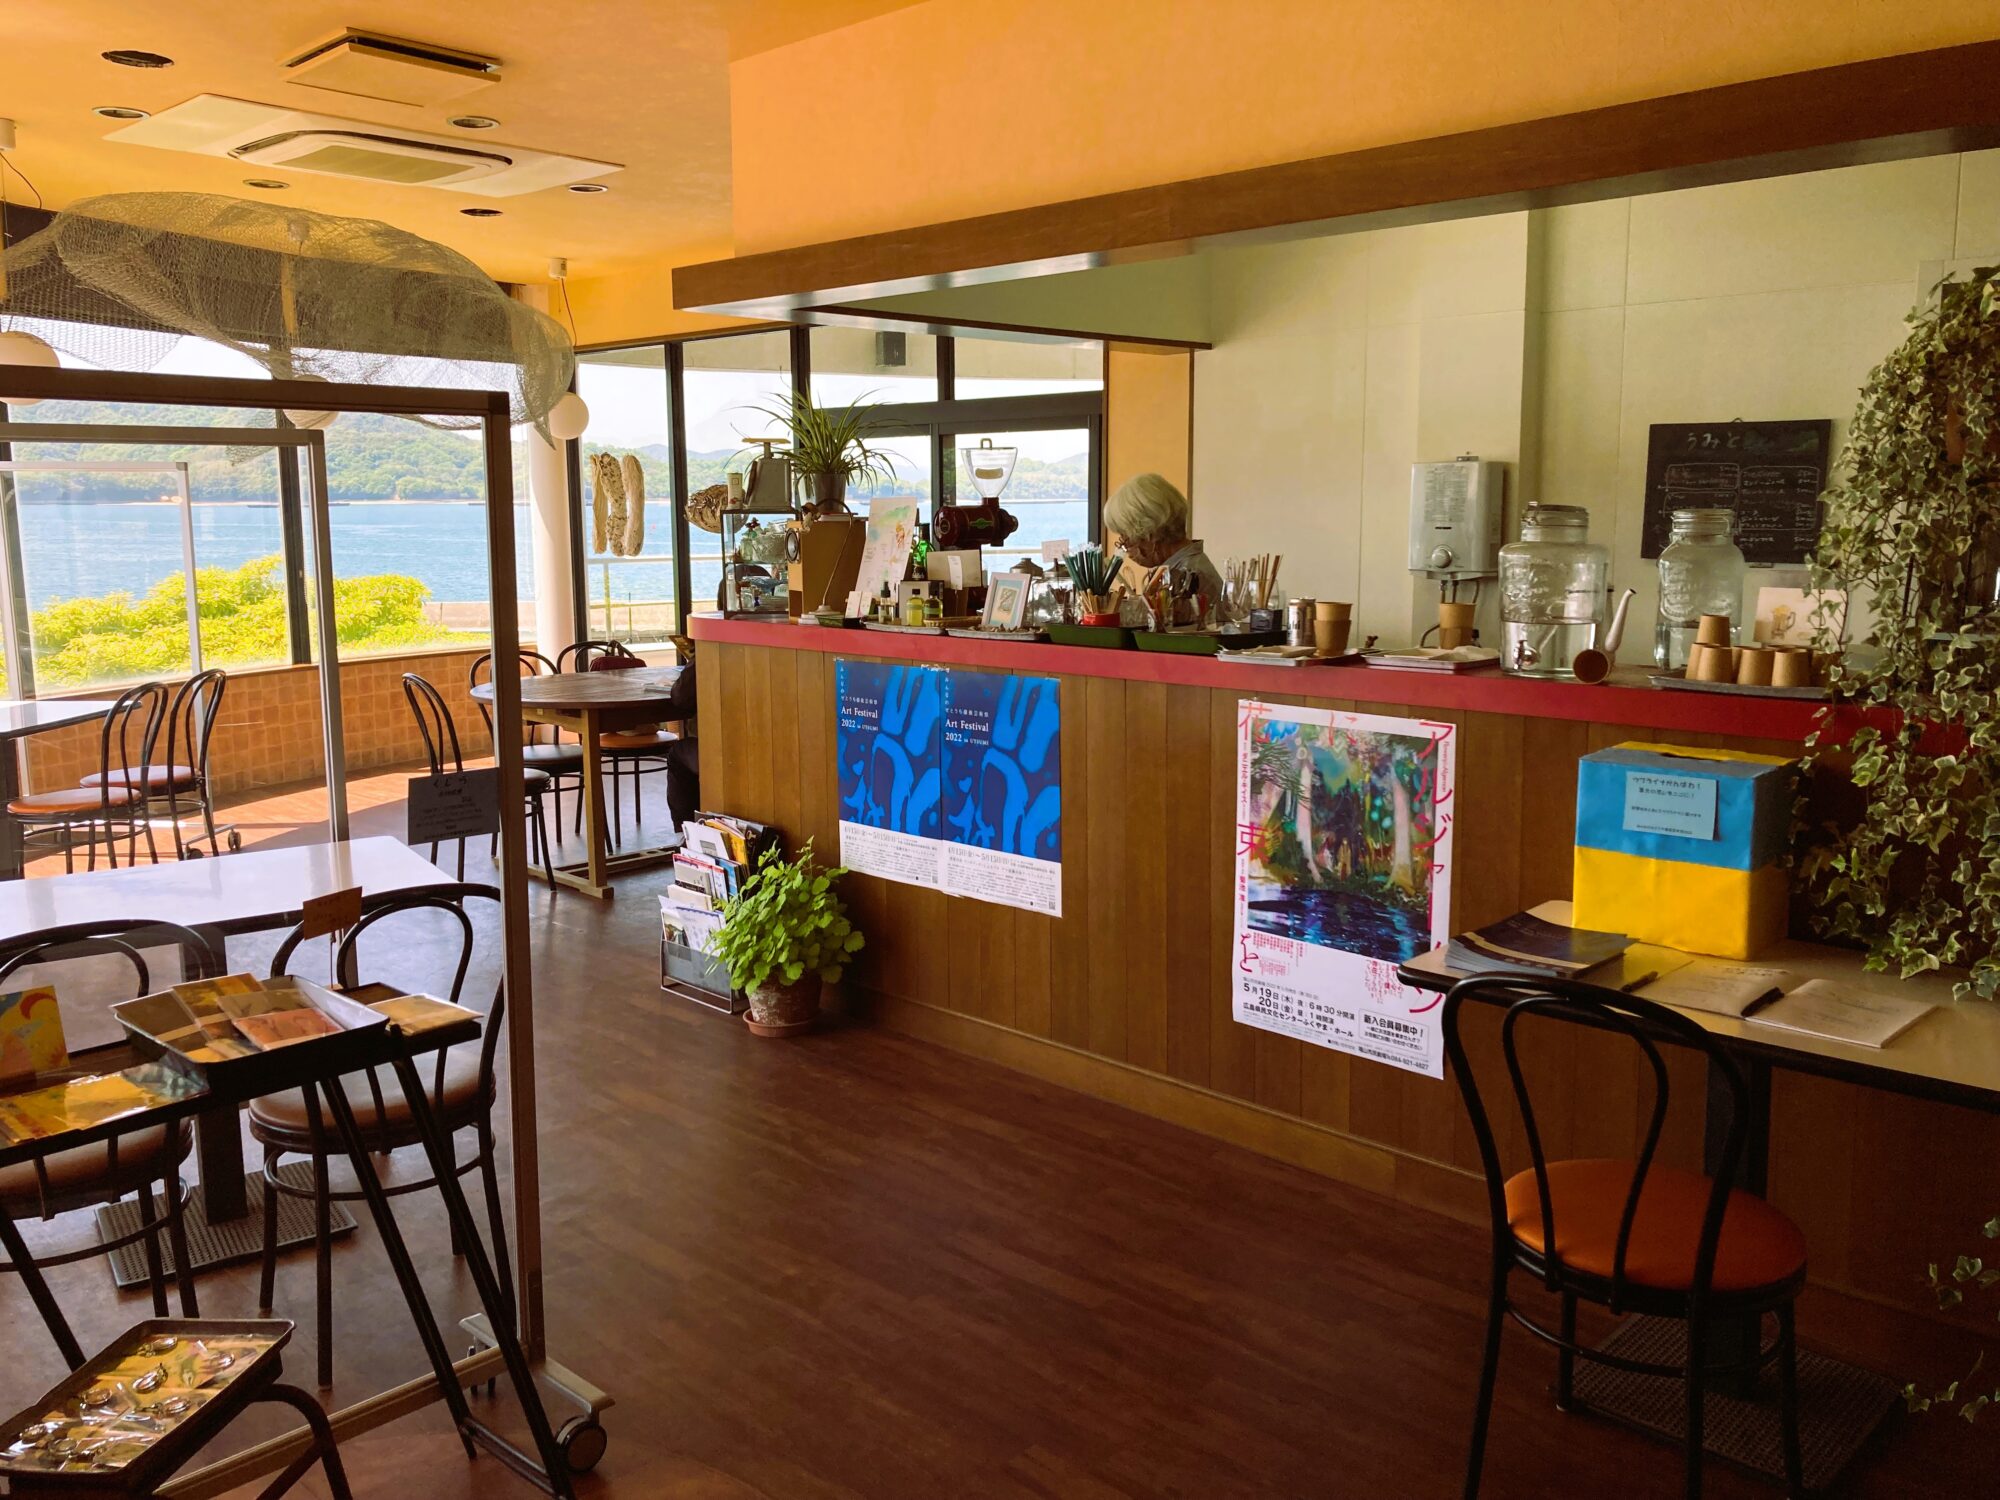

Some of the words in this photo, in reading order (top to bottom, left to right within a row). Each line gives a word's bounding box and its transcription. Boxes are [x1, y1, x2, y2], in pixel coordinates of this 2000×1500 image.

[841, 705, 852, 715] Art
[854, 707, 878, 719] Festival
[841, 718, 856, 729] 2022
[945, 718, 958, 729] Art
[960, 720, 989, 732] Festival
[945, 732, 962, 742] 2022
[1408, 721, 1454, 1014] アルジャーン
